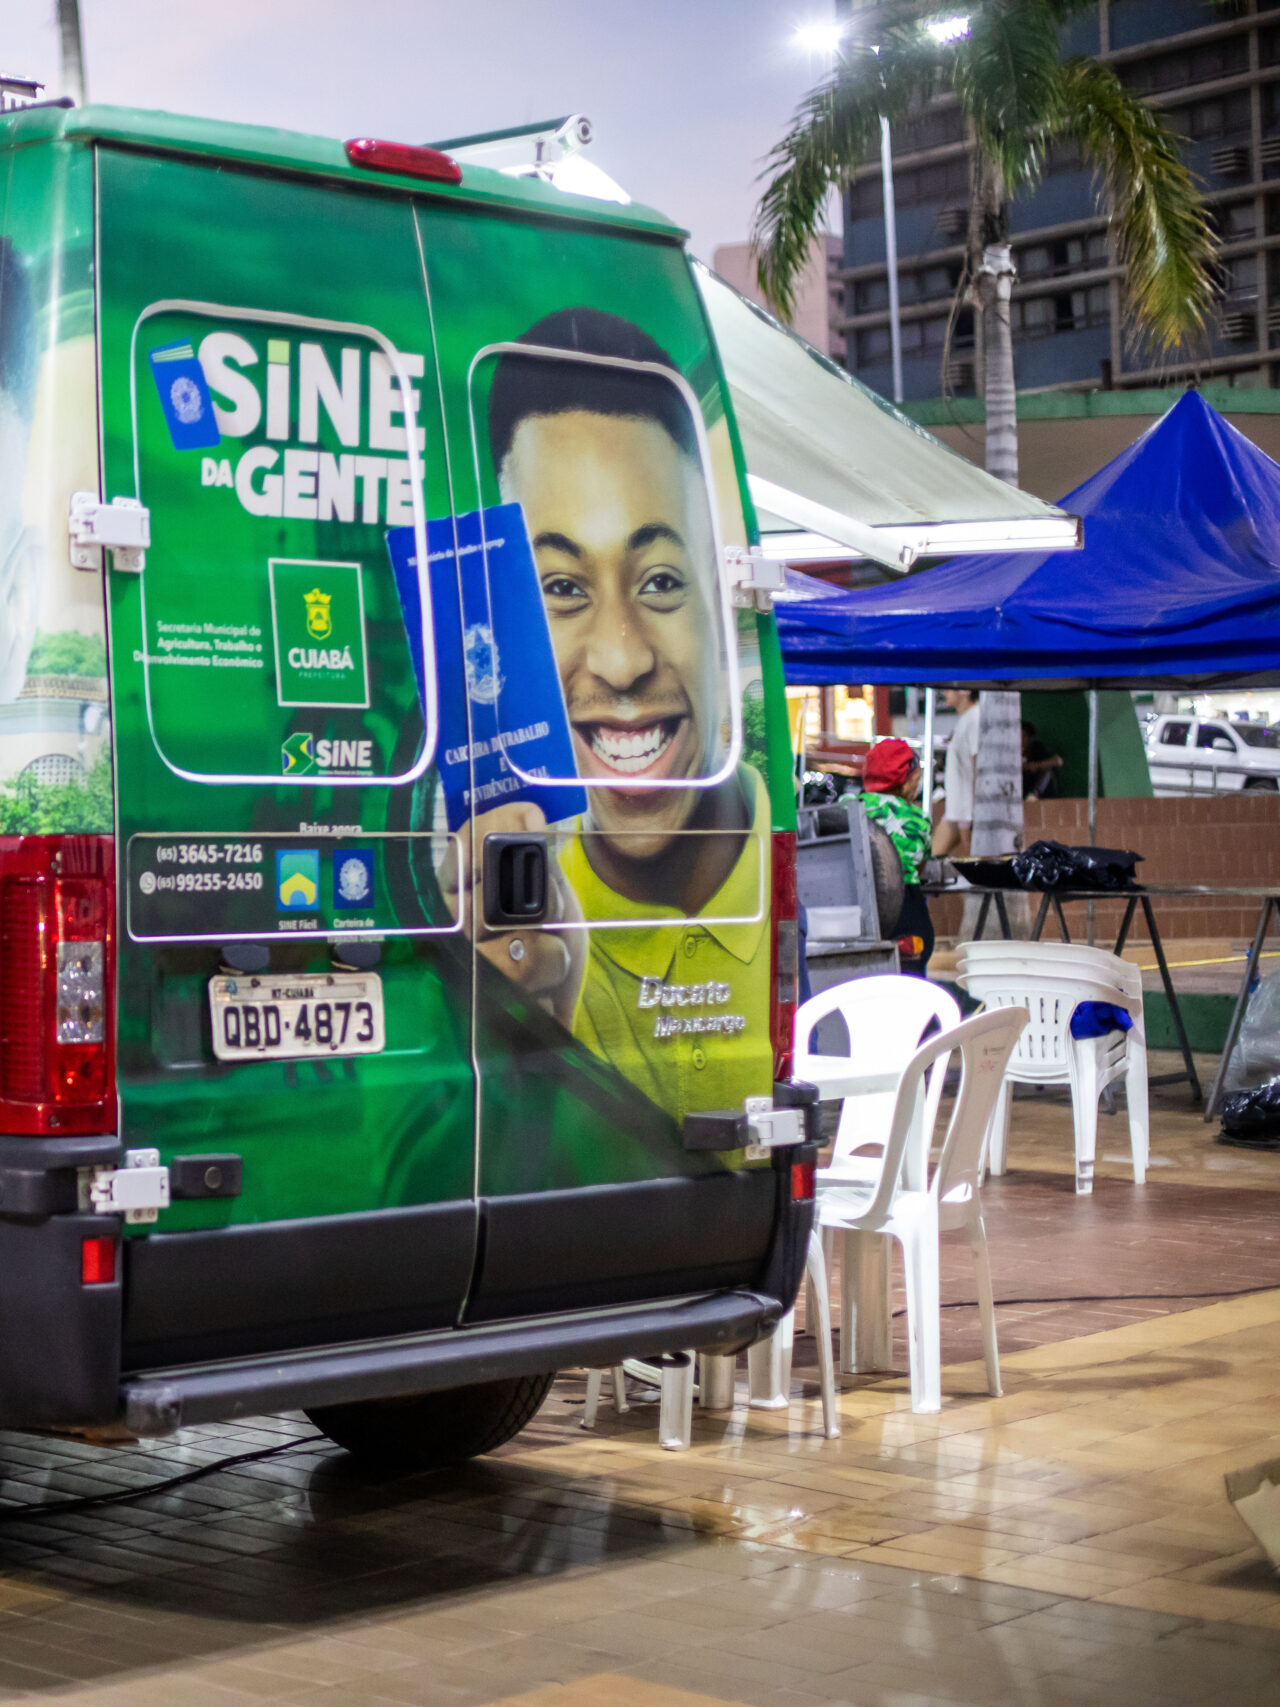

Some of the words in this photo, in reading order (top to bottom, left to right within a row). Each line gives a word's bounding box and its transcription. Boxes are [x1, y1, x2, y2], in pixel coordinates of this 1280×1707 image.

[201, 457, 234, 488] DA
[235, 446, 426, 526] GENTE
[288, 645, 355, 670] CUIABÁ
[178, 844, 263, 864] 3645-7216
[176, 872, 263, 892] 99255-2450
[637, 976, 732, 1009] Ducato
